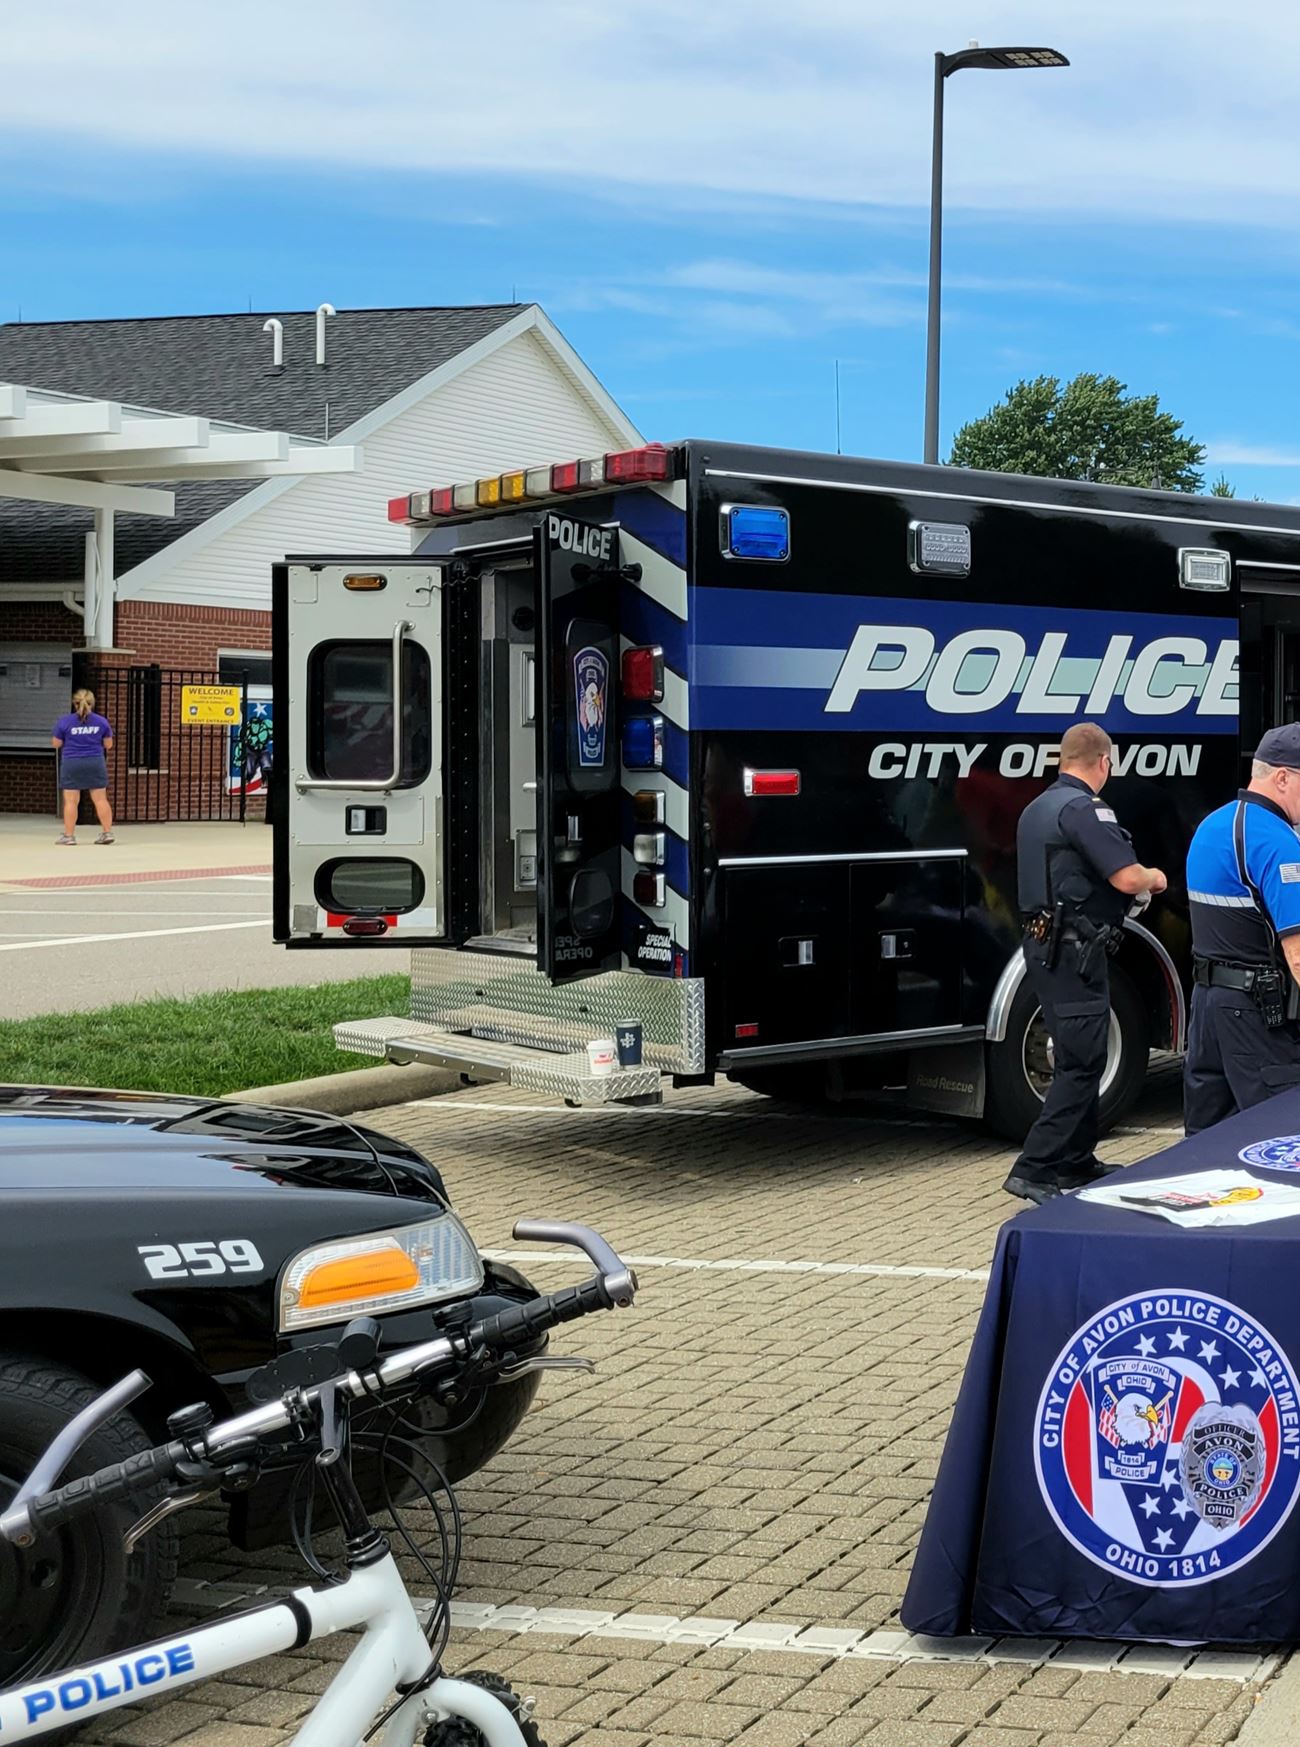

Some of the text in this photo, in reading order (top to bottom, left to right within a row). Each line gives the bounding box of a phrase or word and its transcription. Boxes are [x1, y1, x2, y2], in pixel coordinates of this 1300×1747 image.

[549, 515, 611, 560] POLICE
[824, 624, 1240, 716] POLICE
[188, 687, 234, 696] WELCOME
[71, 726, 100, 735] STAFF
[868, 743, 1202, 779] CITY OF VON
[645, 934, 671, 948] SPECIAL
[939, 1076, 974, 1093] Rescue
[137, 1239, 265, 1279] 259
[1108, 1361, 1166, 1376] CITY of AVON
[1043, 1298, 1300, 1460] CITY OF AVON POLICE DEPARTMENT
[1125, 1376, 1148, 1386] OHIO
[1204, 1424, 1246, 1438] OFFICER
[1204, 1436, 1244, 1451] AVON
[1122, 1456, 1140, 1465] 1814
[1115, 1466, 1145, 1478] POLICE
[1200, 1484, 1244, 1499] POLICE
[1207, 1504, 1233, 1516] OHIO
[1105, 1543, 1221, 1577] OHIO 1814
[23, 1644, 195, 1724] POLICE
